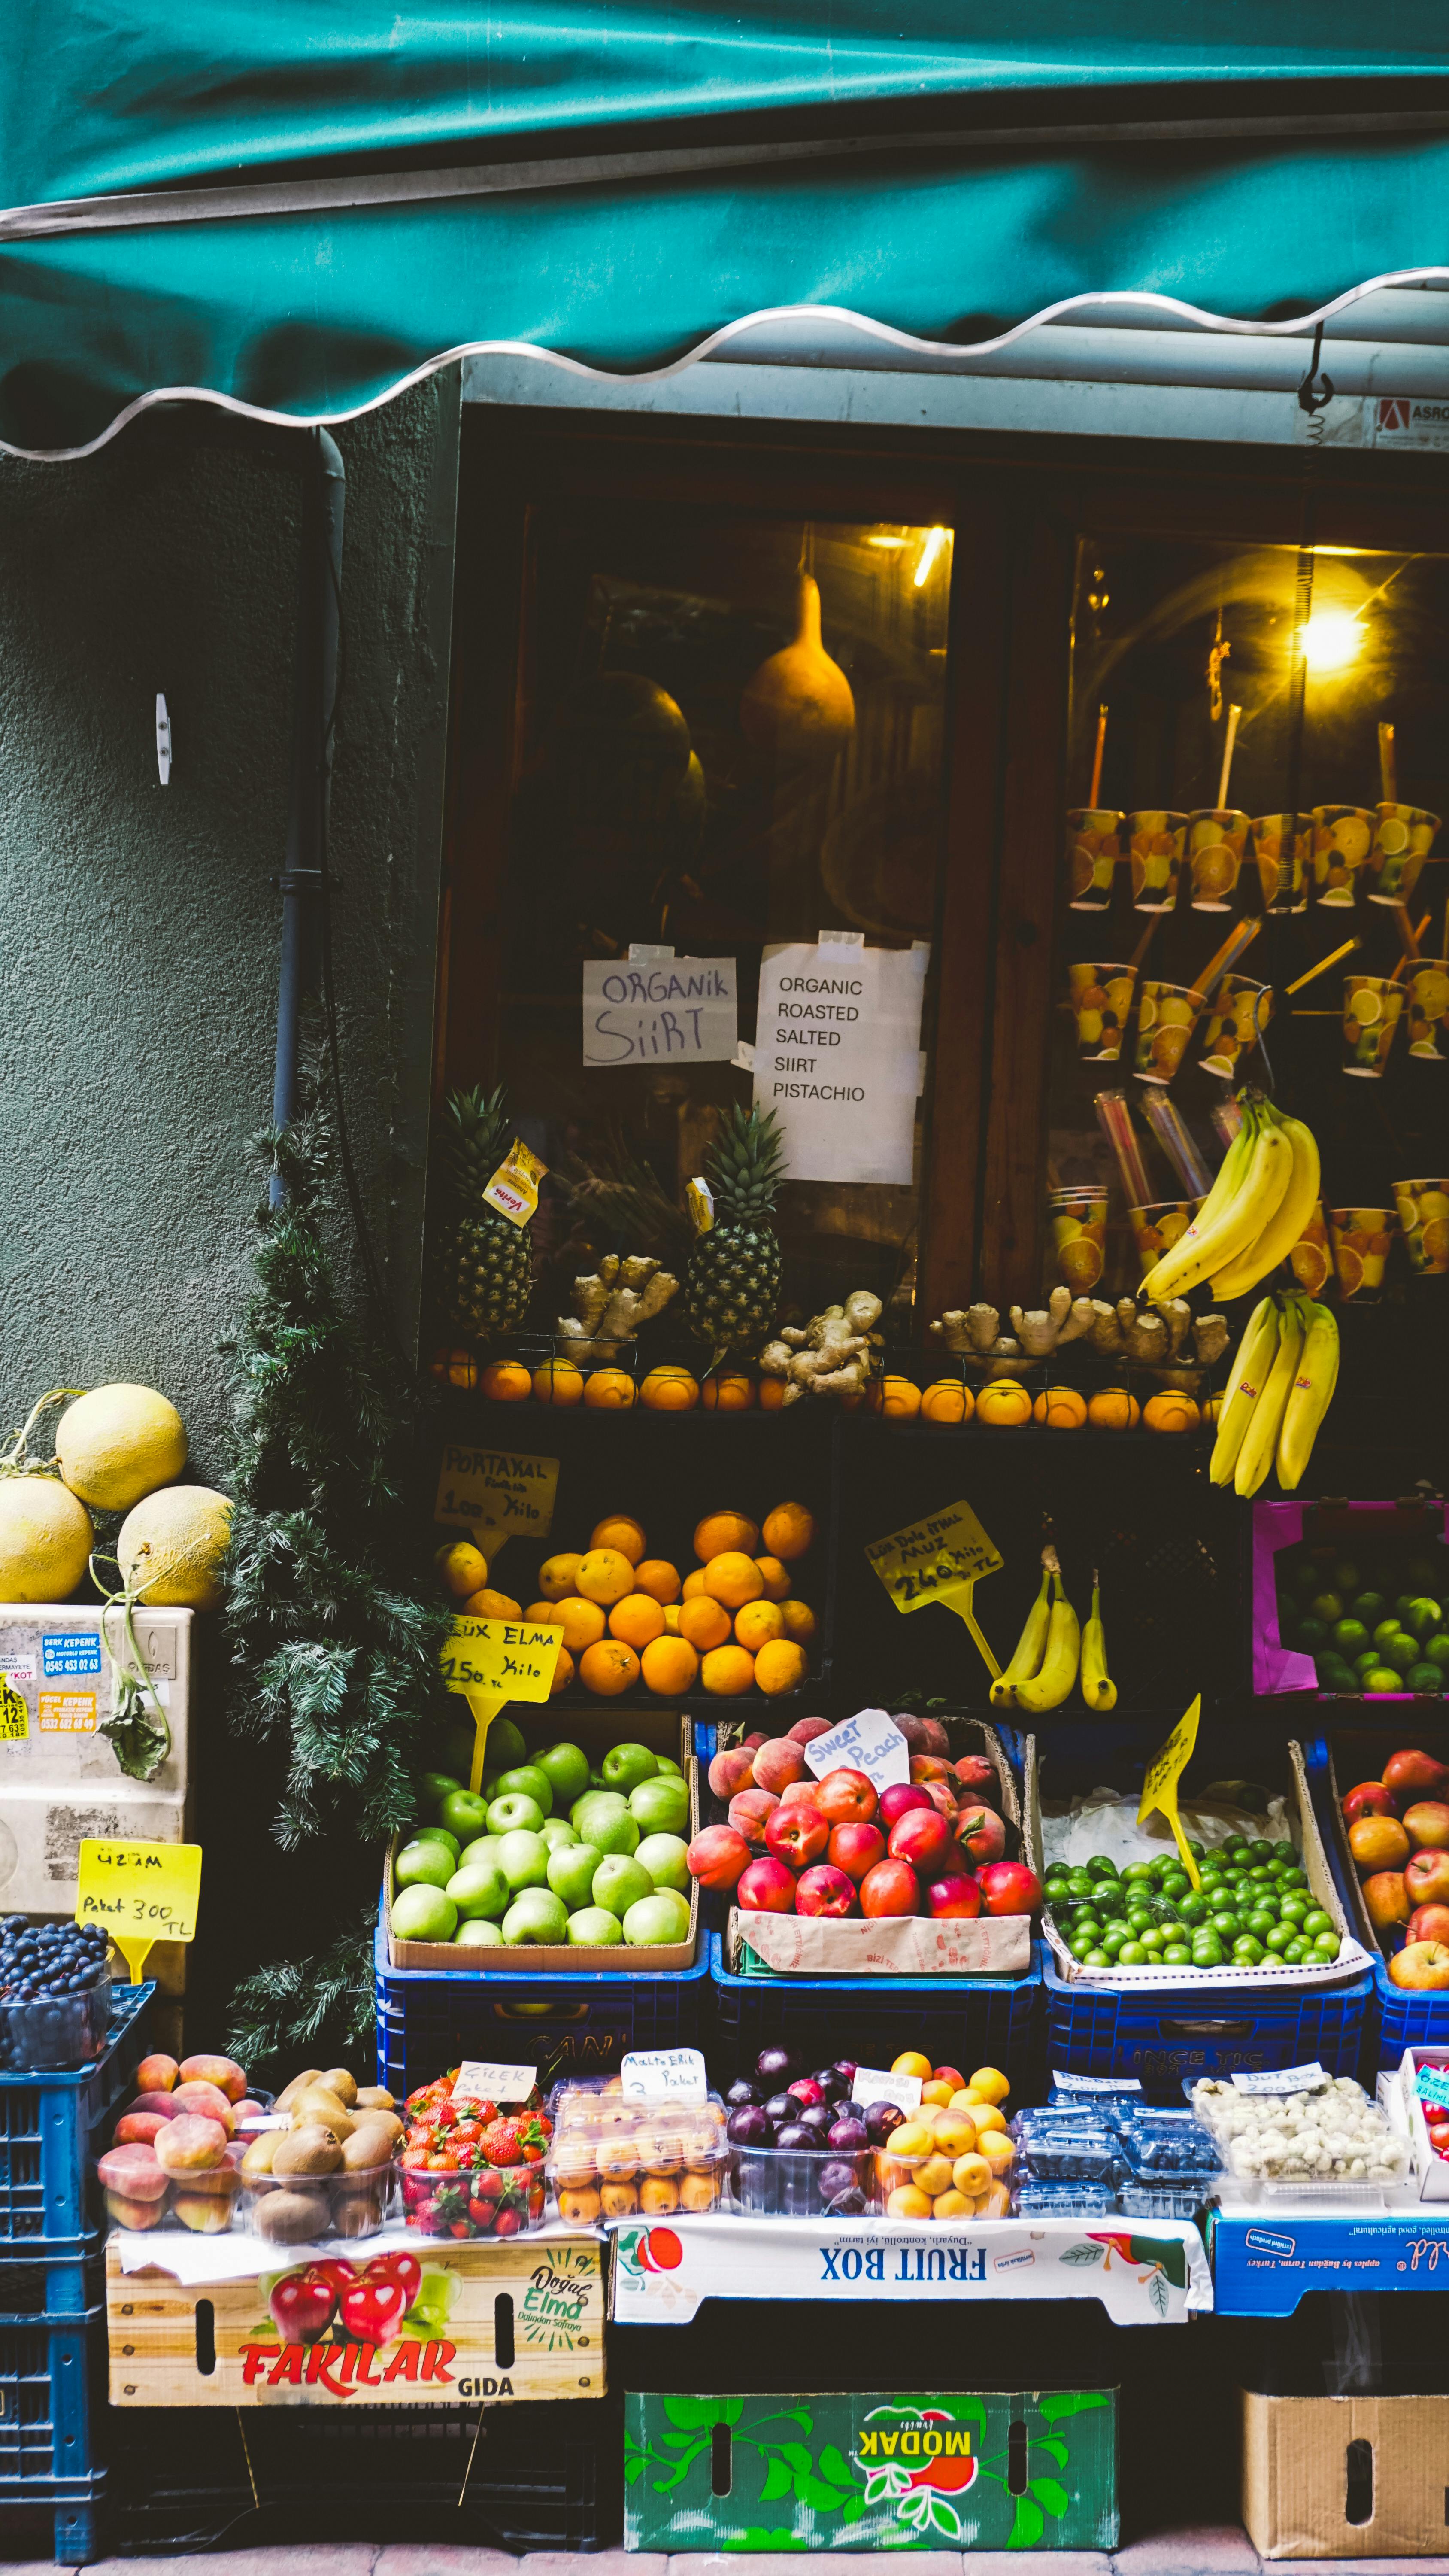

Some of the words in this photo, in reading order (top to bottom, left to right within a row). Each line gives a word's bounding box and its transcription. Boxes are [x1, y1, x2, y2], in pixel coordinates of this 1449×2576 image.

[779, 977, 863, 995] ORGANIC
[778, 1003, 859, 1021] ROASTED
[776, 1029, 840, 1046] SALTED
[774, 1057, 817, 1073] SIIRT
[773, 1083, 865, 1101] PISTACHIO
[901, 1536, 948, 1564] MUZ
[44, 1638, 63, 1646] BERK
[64, 1637, 97, 1648] KEPENK
[503, 1626, 554, 1646] ELMA
[45, 1660, 63, 1672] 0545
[64, 1659, 77, 1671] 453
[79, 1659, 88, 1671] 02
[89, 1658, 98, 1670] 63
[847, 1732, 905, 1768] Peach
[133, 1899, 172, 1920] 300
[162, 1922, 192, 1935] TL
[867, 2236, 878, 2245] iyi
[1398, 2226, 1417, 2236] good
[819, 2248, 885, 2280] BOX
[895, 2248, 987, 2281] FRUIT
[530, 2266, 593, 2296] Doğal
[523, 2287, 584, 2320] Elma
[238, 2339, 456, 2398] FAKILAR
[458, 2377, 514, 2397] GIDA
[859, 2431, 970, 2456] MODAK
